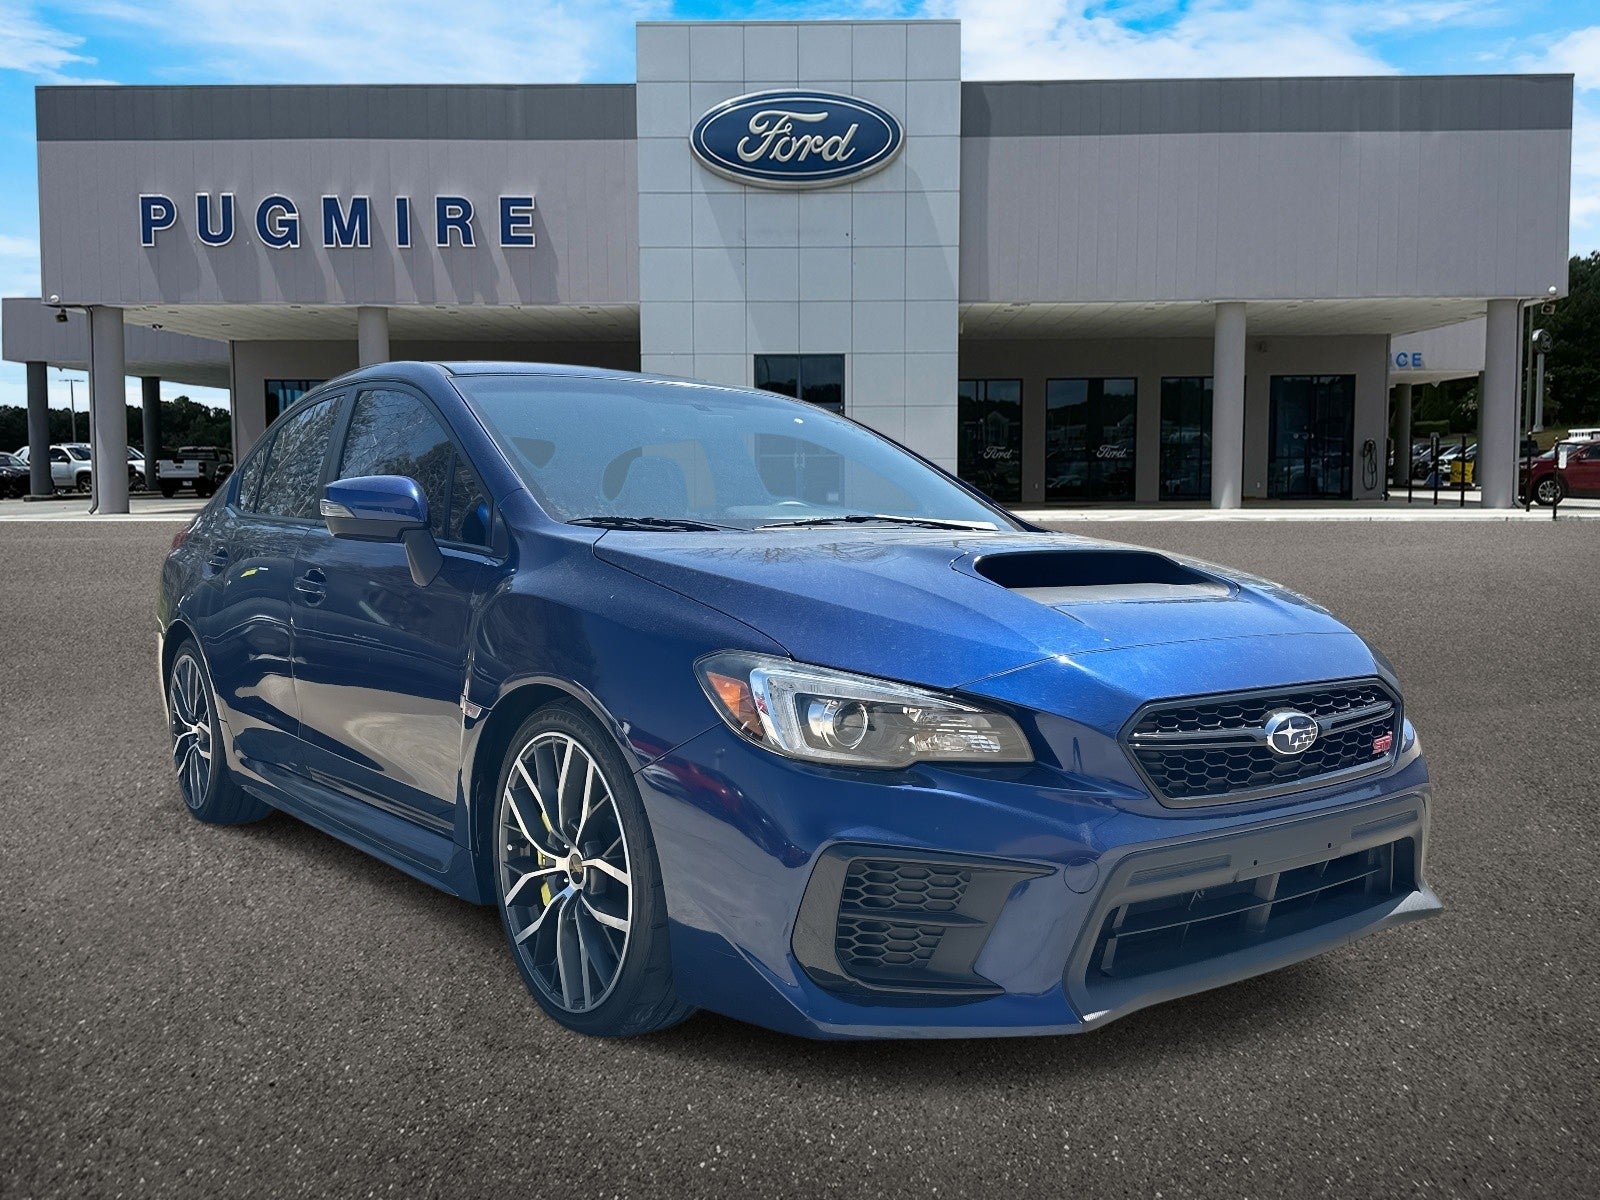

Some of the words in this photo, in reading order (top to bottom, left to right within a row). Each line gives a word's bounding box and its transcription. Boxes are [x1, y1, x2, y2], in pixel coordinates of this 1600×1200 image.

[736, 109, 860, 163] Ford
[138, 191, 537, 250] PUGMIRE
[1390, 352, 1422, 368] CE
[983, 445, 1013, 460] Ford
[1096, 444, 1127, 459] Ford
